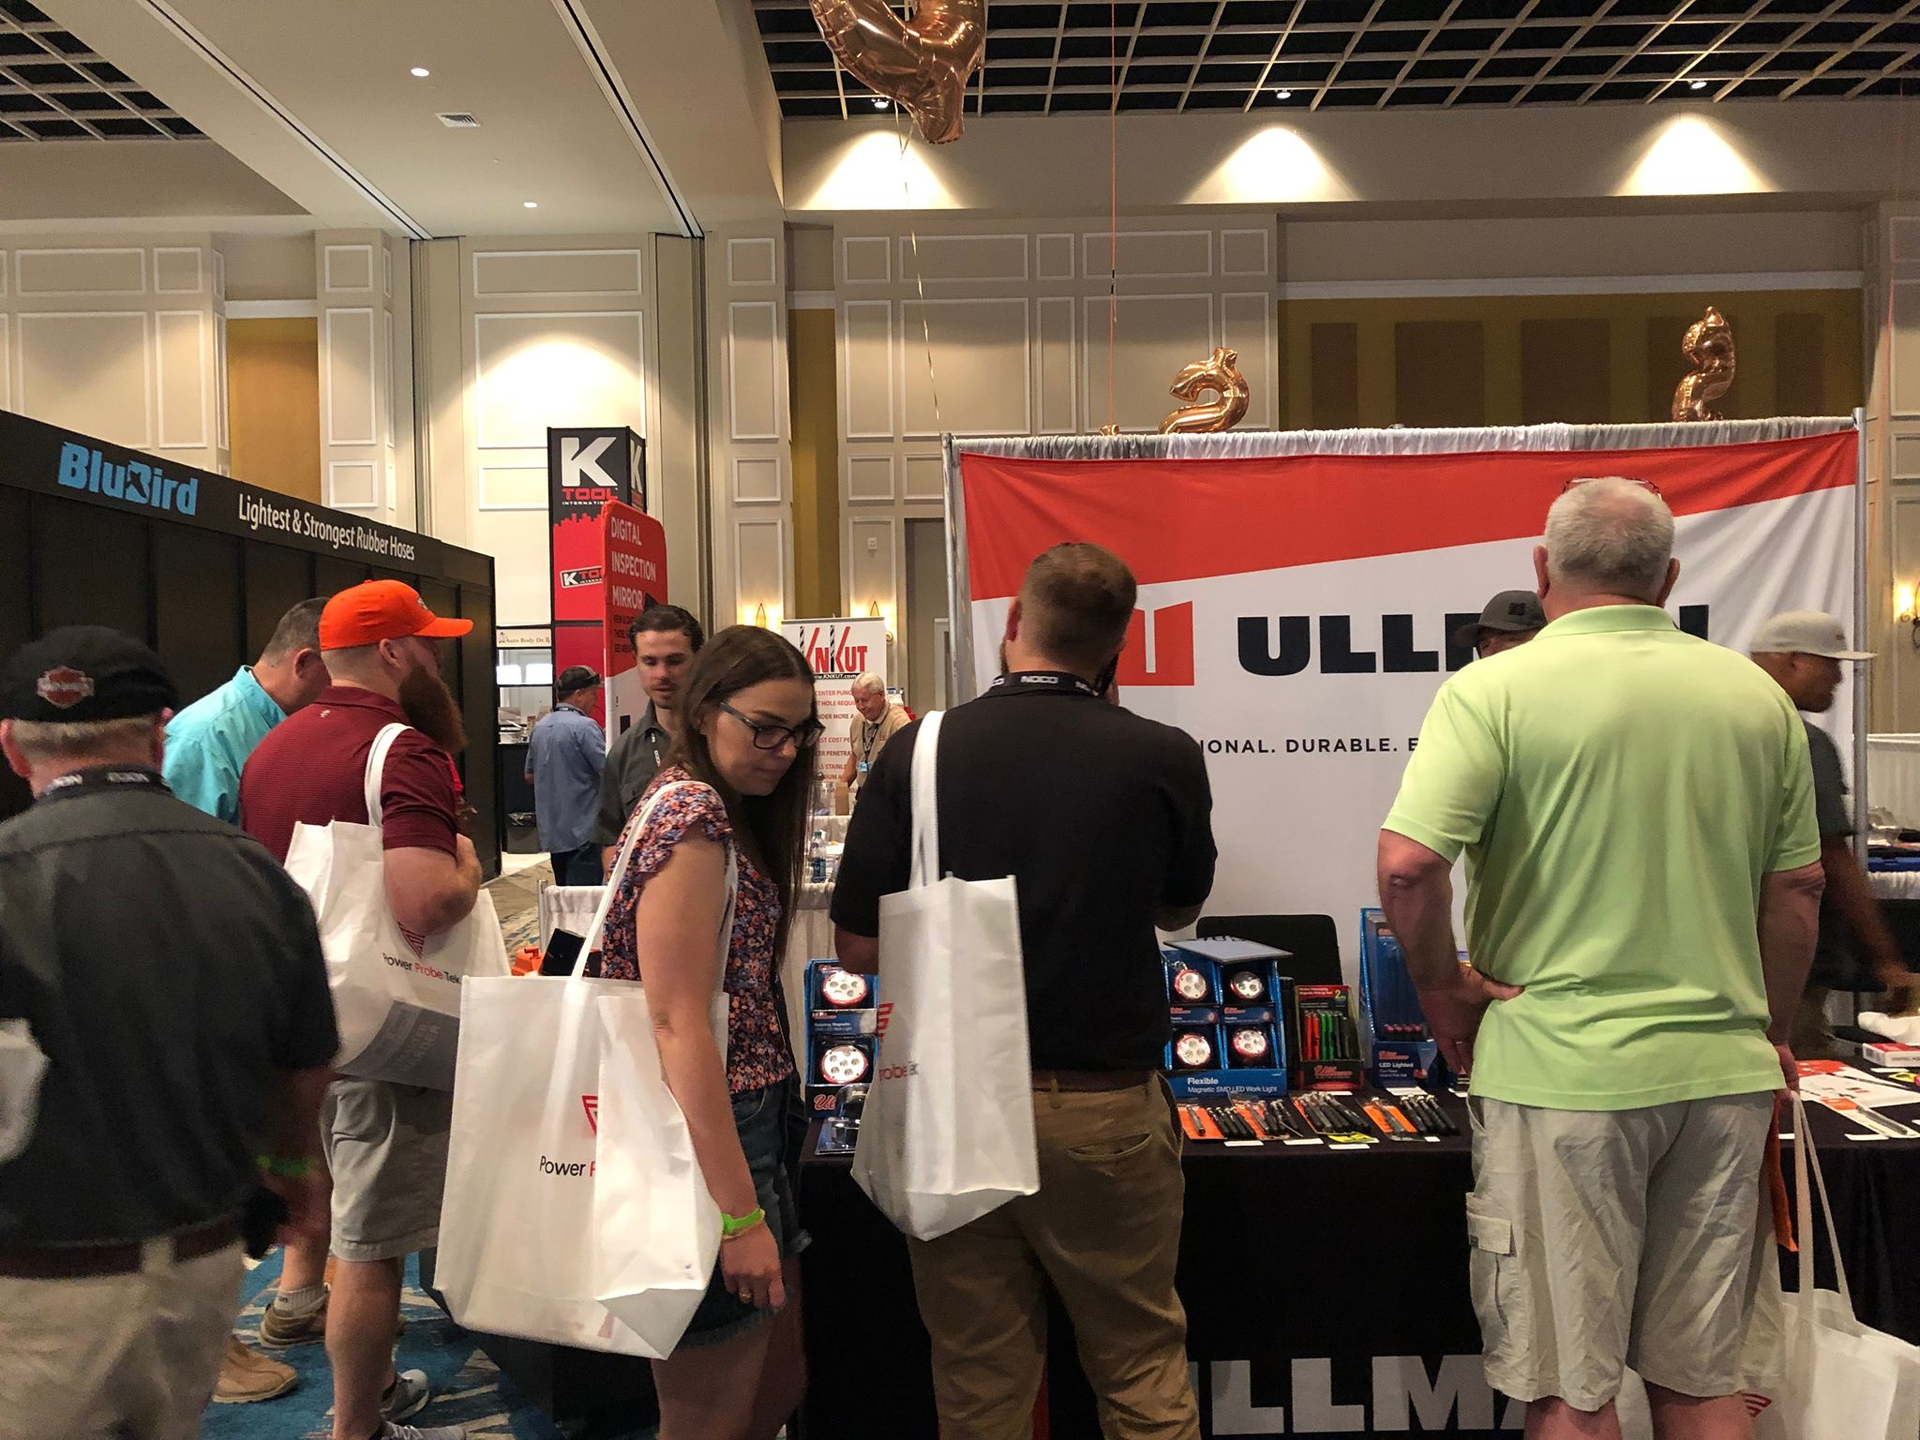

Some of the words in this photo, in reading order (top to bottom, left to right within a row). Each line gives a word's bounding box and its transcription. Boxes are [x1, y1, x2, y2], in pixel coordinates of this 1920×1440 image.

[561, 436, 618, 487] K
[58, 441, 199, 516] BluBird
[562, 488, 618, 501] TOOL
[239, 493, 291, 531] Lightest
[292, 508, 302, 534] &
[303, 512, 355, 550] Strongest
[356, 526, 389, 555] Rubber
[390, 535, 416, 561] Hoses
[611, 516, 642, 546] DIGITAL
[563, 571, 579, 586] K
[579, 569, 602, 580] TO
[611, 551, 656, 582] INSPECTION
[612, 585, 643, 611] MIRROR
[1200, 739, 1276, 753] IONAL.
[1286, 738, 1398, 753] DURABLE.
[414, 962, 443, 980] Probe
[1187, 1077, 1219, 1085] Flexible
[1187, 1086, 1215, 1094] Magnetic
[1262, 1085, 1277, 1093] Light
[540, 1155, 586, 1176] Power
[1188, 1354, 1526, 1436] LLM
